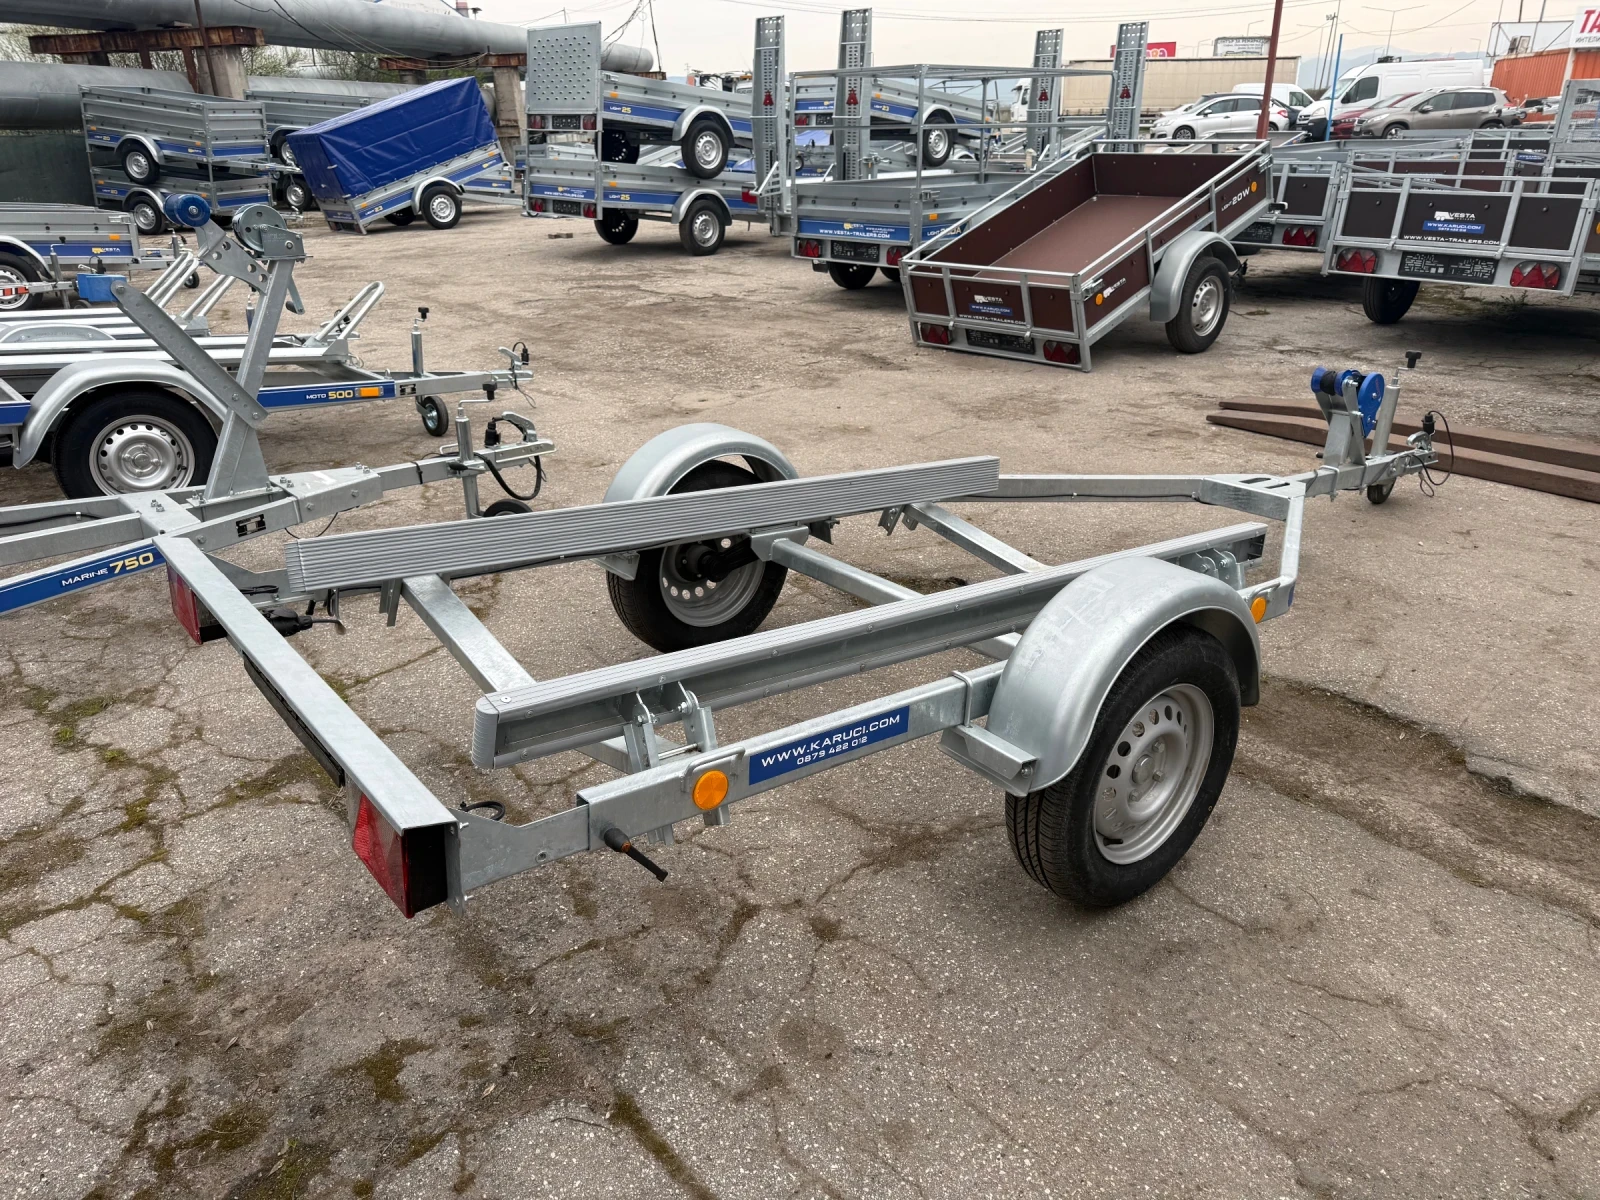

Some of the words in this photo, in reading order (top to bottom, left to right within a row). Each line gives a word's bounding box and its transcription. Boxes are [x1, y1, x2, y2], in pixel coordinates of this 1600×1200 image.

[1232, 186, 1250, 206] 20W
[819, 229, 891, 239] WWW.VESTA-TRAILERS.COM
[1404, 235, 1500, 245] WWW.VESTA-TRAILERS.COM
[328, 390, 354, 399] 500
[61, 567, 109, 587] MARINE
[109, 552, 154, 574] 750
[761, 714, 900, 767] WWW.KARUCI.COM
[797, 750, 826, 765] 0879
[829, 742, 849, 754] 422
[851, 735, 868, 747] 012
